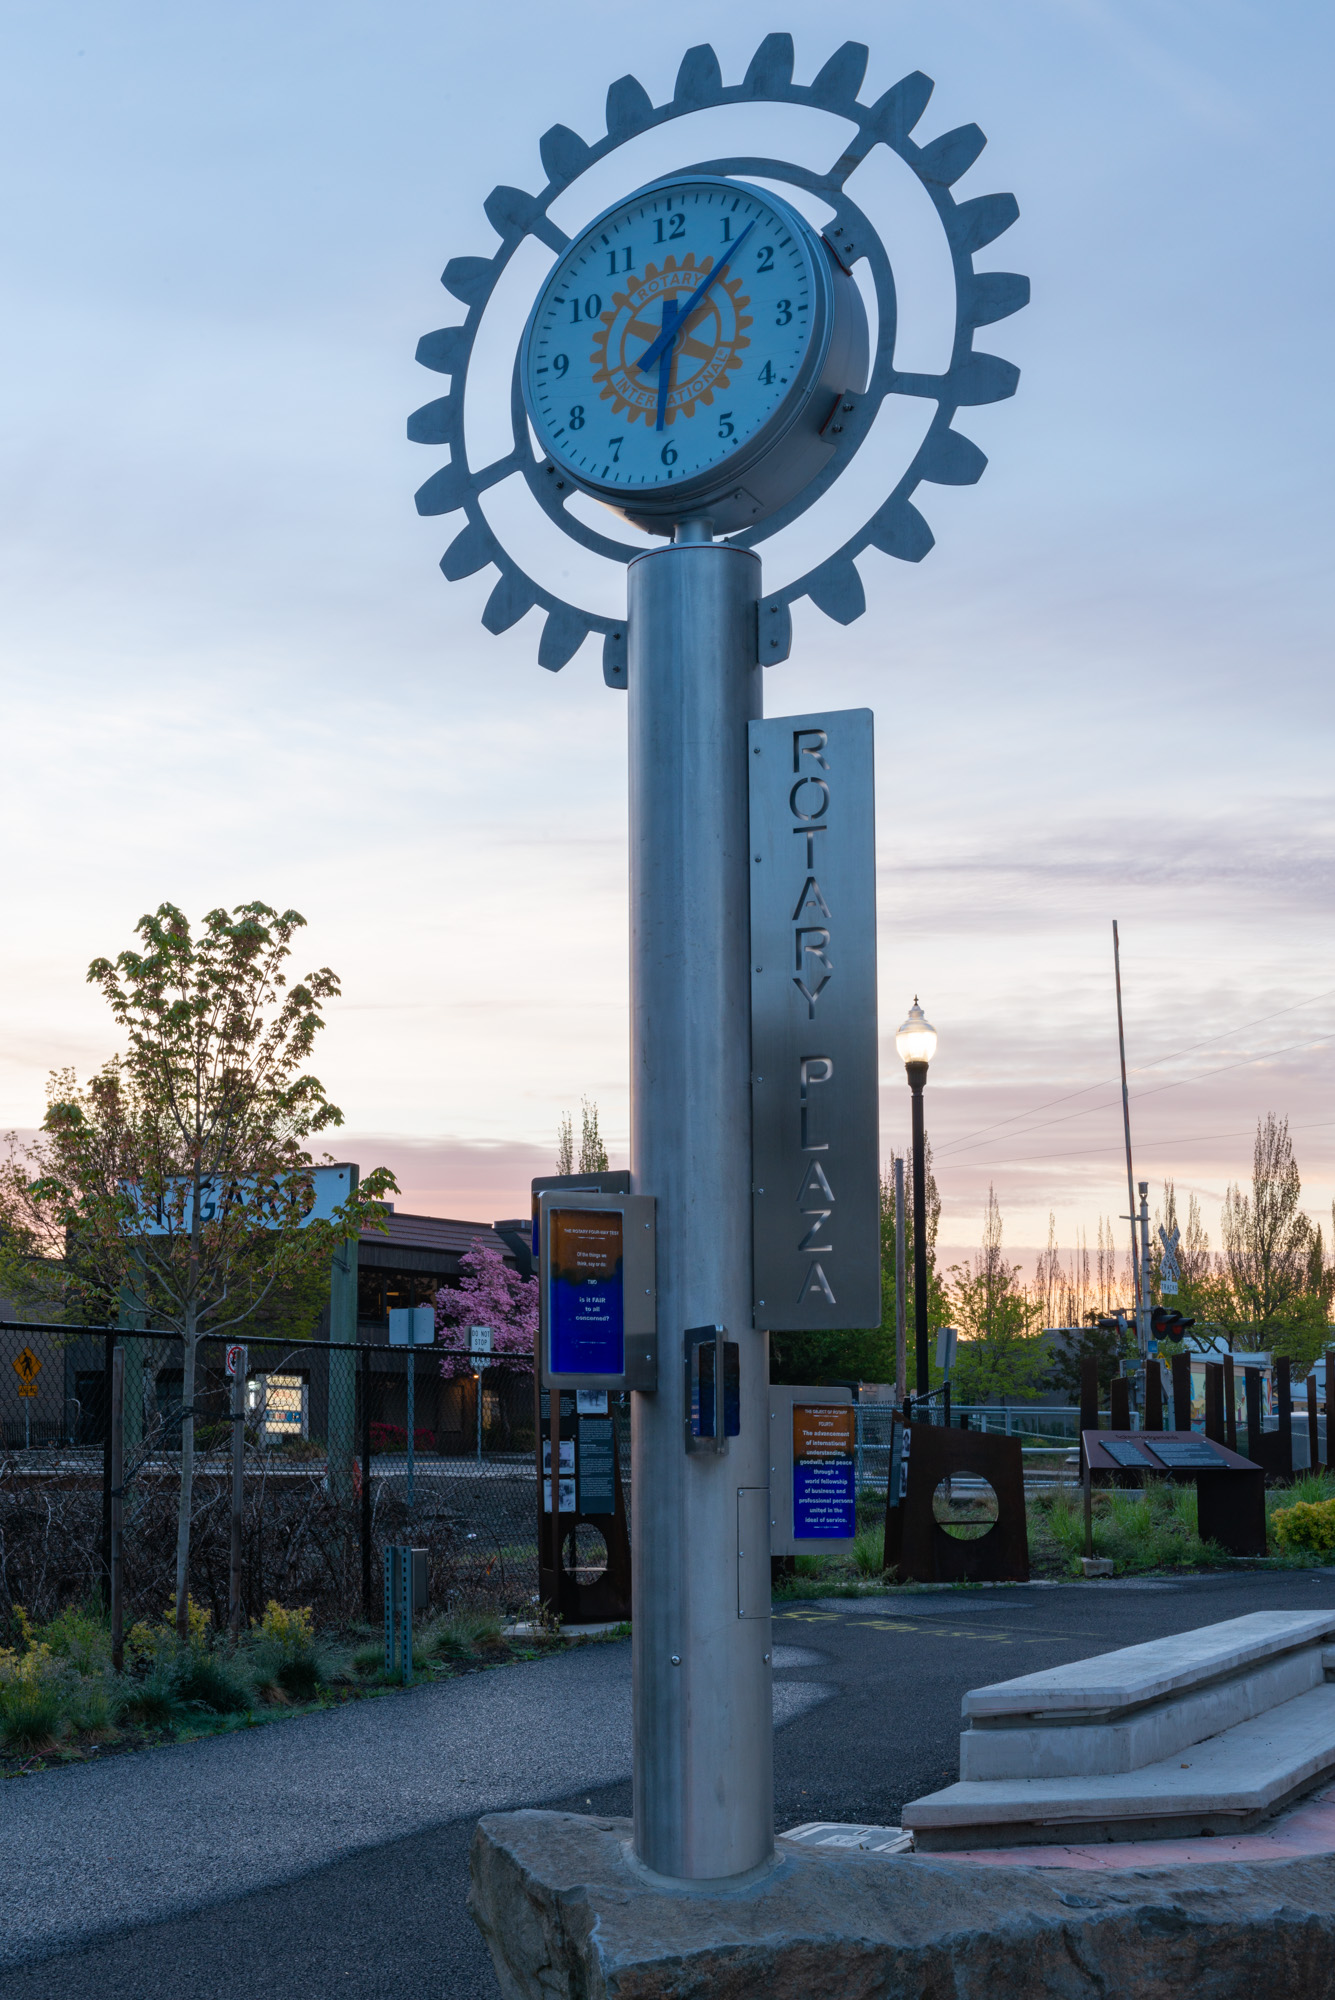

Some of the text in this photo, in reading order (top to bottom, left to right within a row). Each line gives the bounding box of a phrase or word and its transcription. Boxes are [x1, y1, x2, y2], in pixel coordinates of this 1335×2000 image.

[653, 213, 686, 245] 12
[720, 216, 735, 244] 1
[606, 246, 636, 277] 11
[756, 245, 775, 274] 2
[637, 272, 704, 301] ROTARY
[569, 293, 602, 324] 10
[775, 299, 793, 326] 3
[552, 353, 570, 380] 9
[616, 352, 728, 408] INTERATIONAL
[757, 359, 777, 386] 4
[568, 405, 586, 431] 8
[717, 411, 735, 439] 5
[607, 436, 625, 463] 7
[660, 439, 679, 466] 6
[789, 728, 836, 1304] ROTARY PLAZA
[148, 1177, 314, 1226] GARD
[1161, 1283, 1178, 1292] TRACKS
[1167, 1271, 1172, 1281] 2
